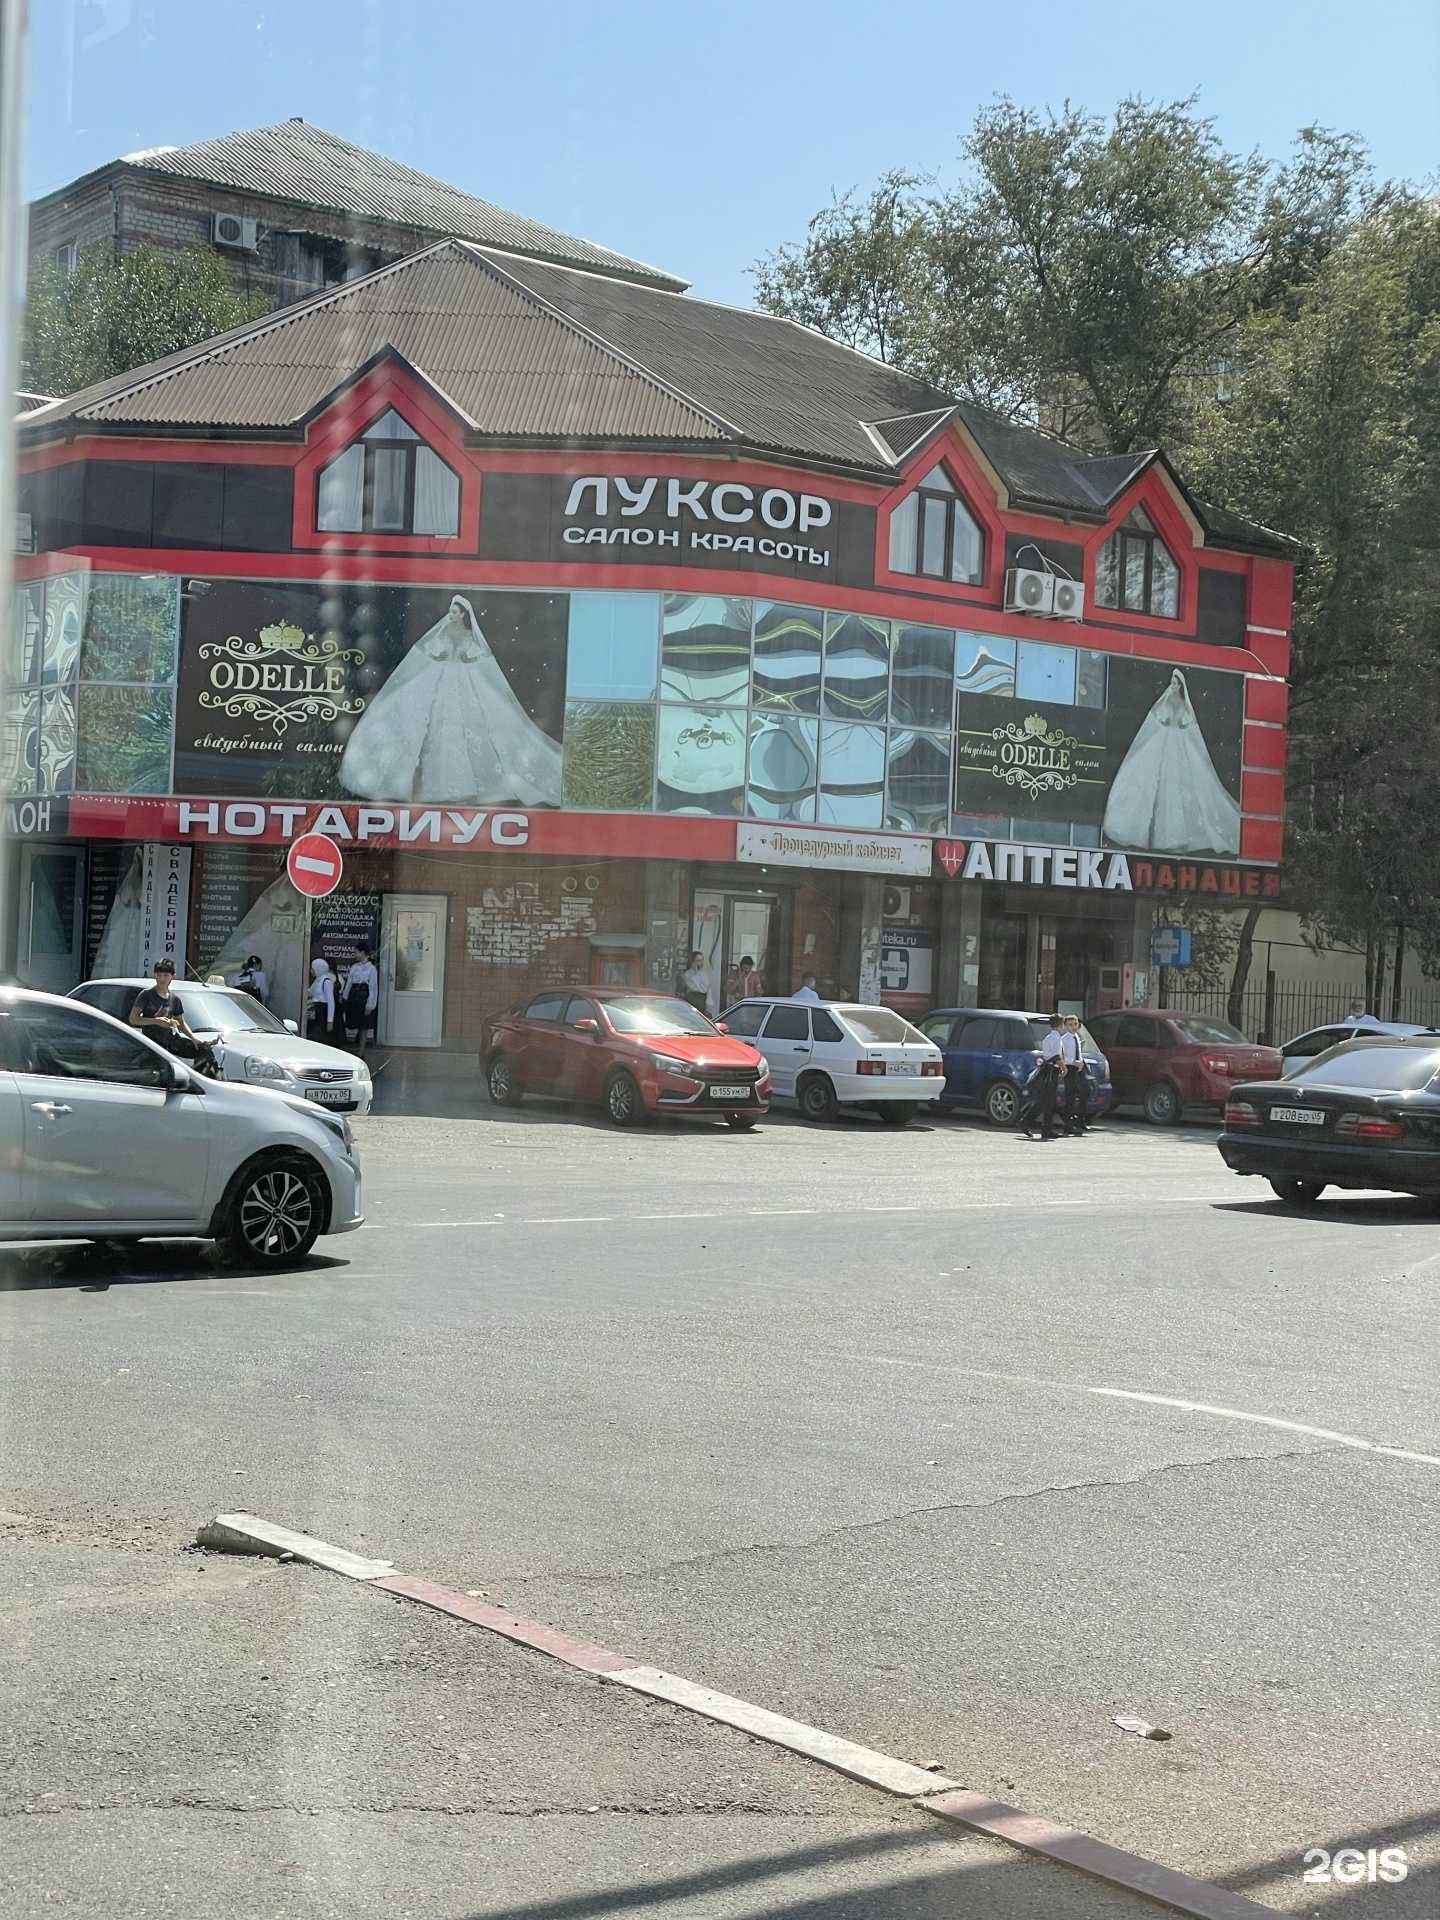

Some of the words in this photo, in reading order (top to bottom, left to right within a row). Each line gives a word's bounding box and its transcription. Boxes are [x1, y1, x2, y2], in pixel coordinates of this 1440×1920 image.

[564, 477, 832, 532] ЛУКСОР
[563, 527, 679, 547] САЛОН
[691, 532, 830, 566] КРАСОТЫ
[210, 662, 345, 693] ODELLE
[194, 734, 283, 753] свадебный
[296, 739, 344, 753] салон
[1001, 743, 1070, 770] ODELLE
[178, 802, 529, 845] НОТАРИУС
[773, 832, 853, 859] Процедурный
[856, 841, 902, 861] кабинет
[963, 841, 1134, 891] АПТЕКА
[1134, 861, 1281, 897] ПАНАЦЕЯ
[165, 847, 180, 953] СВАДЕБНЫЙ
